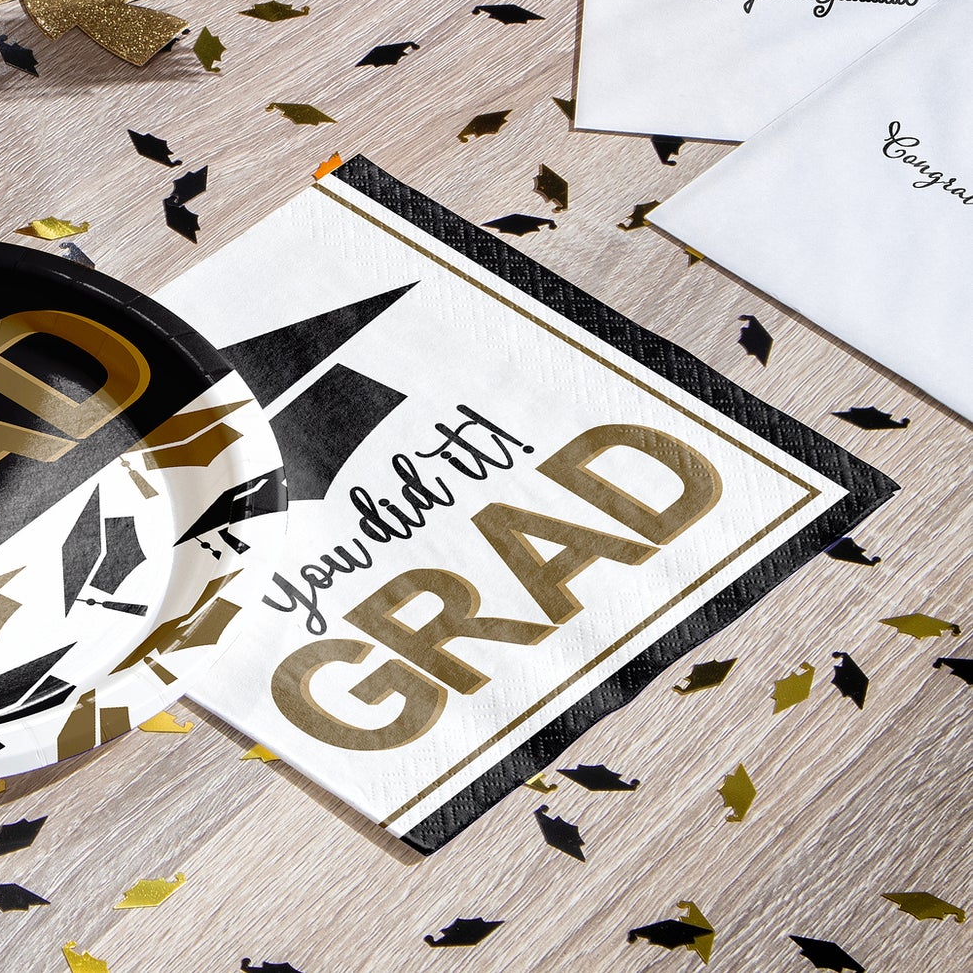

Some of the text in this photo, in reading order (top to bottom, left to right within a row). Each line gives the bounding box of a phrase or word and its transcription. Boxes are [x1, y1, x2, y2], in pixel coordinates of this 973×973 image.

[270, 423, 723, 751] GRAD
[349, 453, 455, 543] did
[415, 404, 535, 480] it!
